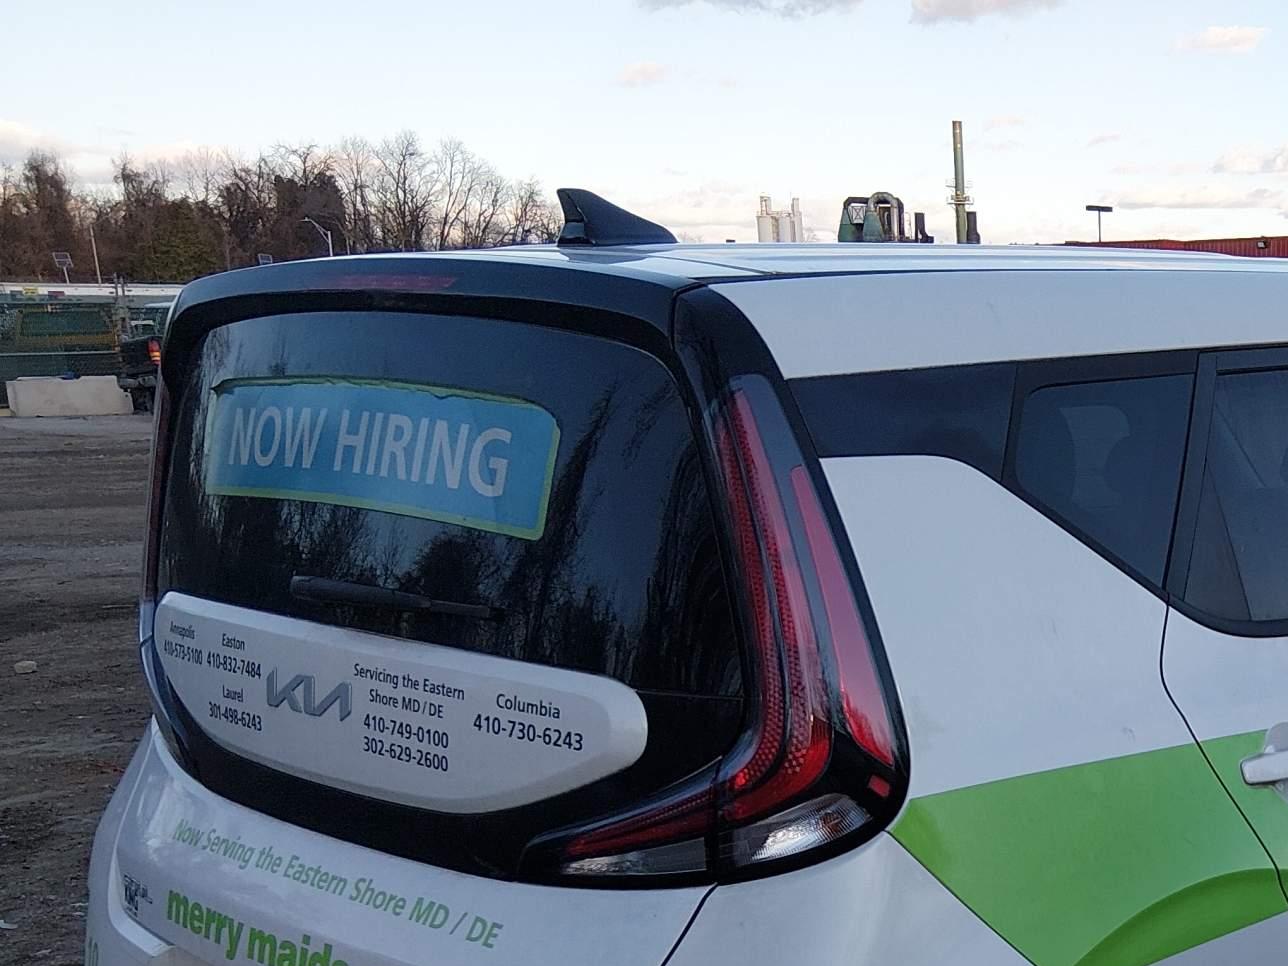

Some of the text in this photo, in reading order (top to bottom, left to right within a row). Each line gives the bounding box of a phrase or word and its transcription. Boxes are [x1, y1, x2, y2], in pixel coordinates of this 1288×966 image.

[228, 406, 513, 498] NOW HIRING
[163, 639, 203, 665] 410-573-5100
[221, 633, 246, 651] Easton
[206, 651, 262, 679] 410-832-7484
[222, 684, 244, 702] Laurel
[353, 663, 466, 701] Servicing the Eastern
[208, 701, 262, 732] 301-498-6243
[369, 688, 399, 708] Shore
[401, 696, 421, 714] MD
[429, 702, 445, 719] DE
[496, 693, 561, 719] Columbia
[363, 713, 449, 749] 410-749-0100
[473, 713, 583, 752] 410-730-6243
[363, 736, 449, 772] 302-629-2600
[172, 818, 504, 949] Now Serving the Eastern Shore MD / DE
[166, 888, 244, 962] merry
